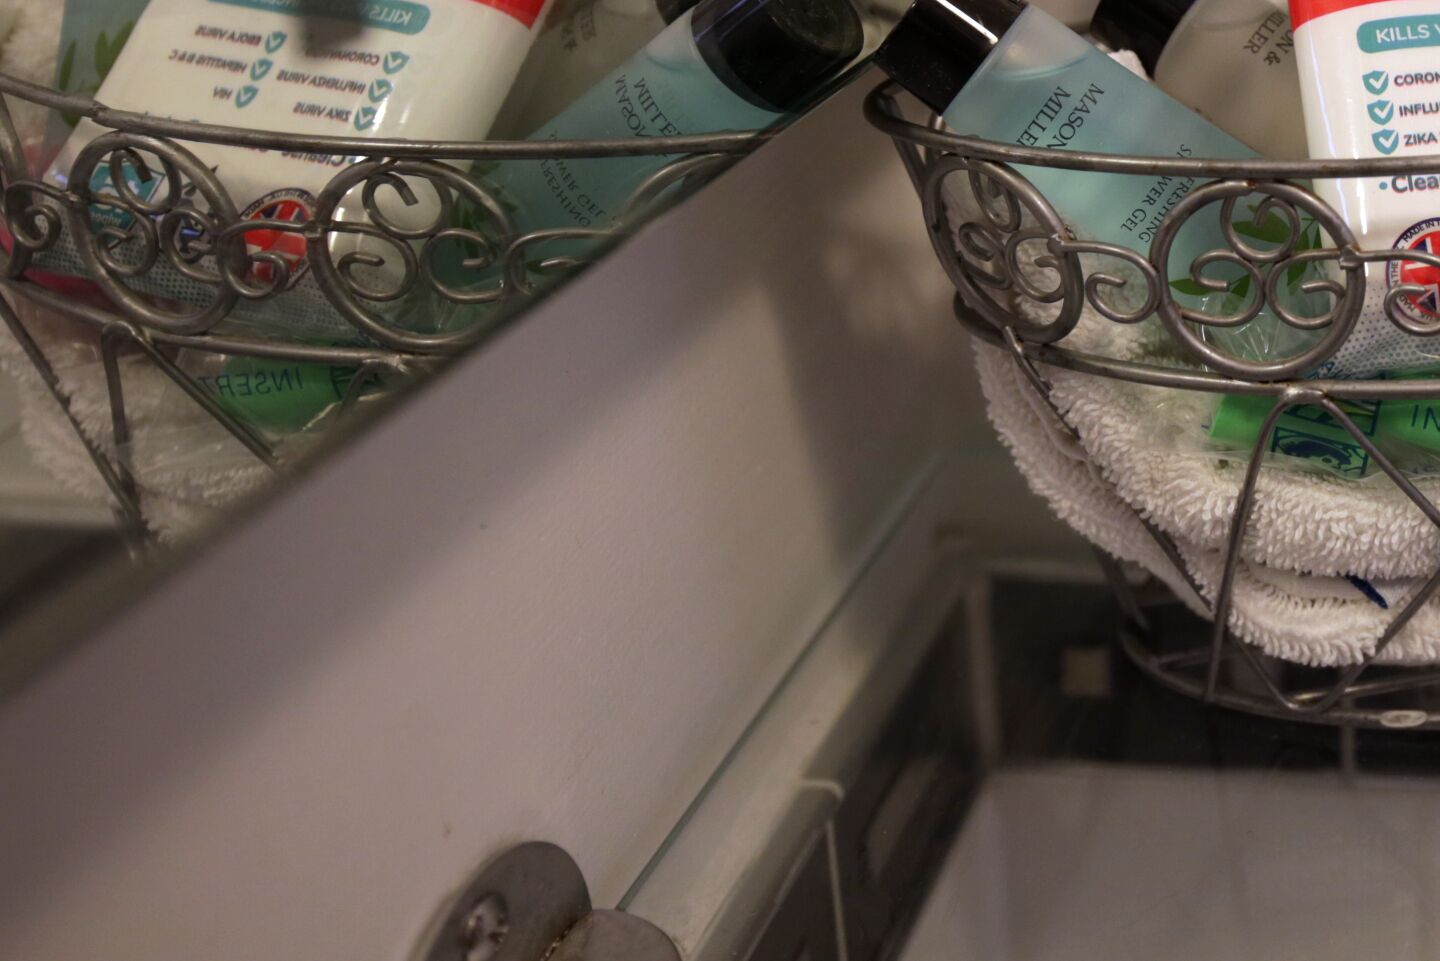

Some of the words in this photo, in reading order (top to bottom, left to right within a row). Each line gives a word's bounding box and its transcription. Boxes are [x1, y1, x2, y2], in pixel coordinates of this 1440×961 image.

[1375, 25, 1430, 44] KILLS
[1015, 85, 1073, 147] MILLE
[1403, 131, 1439, 148] ZIKA
[1119, 208, 1148, 232] GEL
